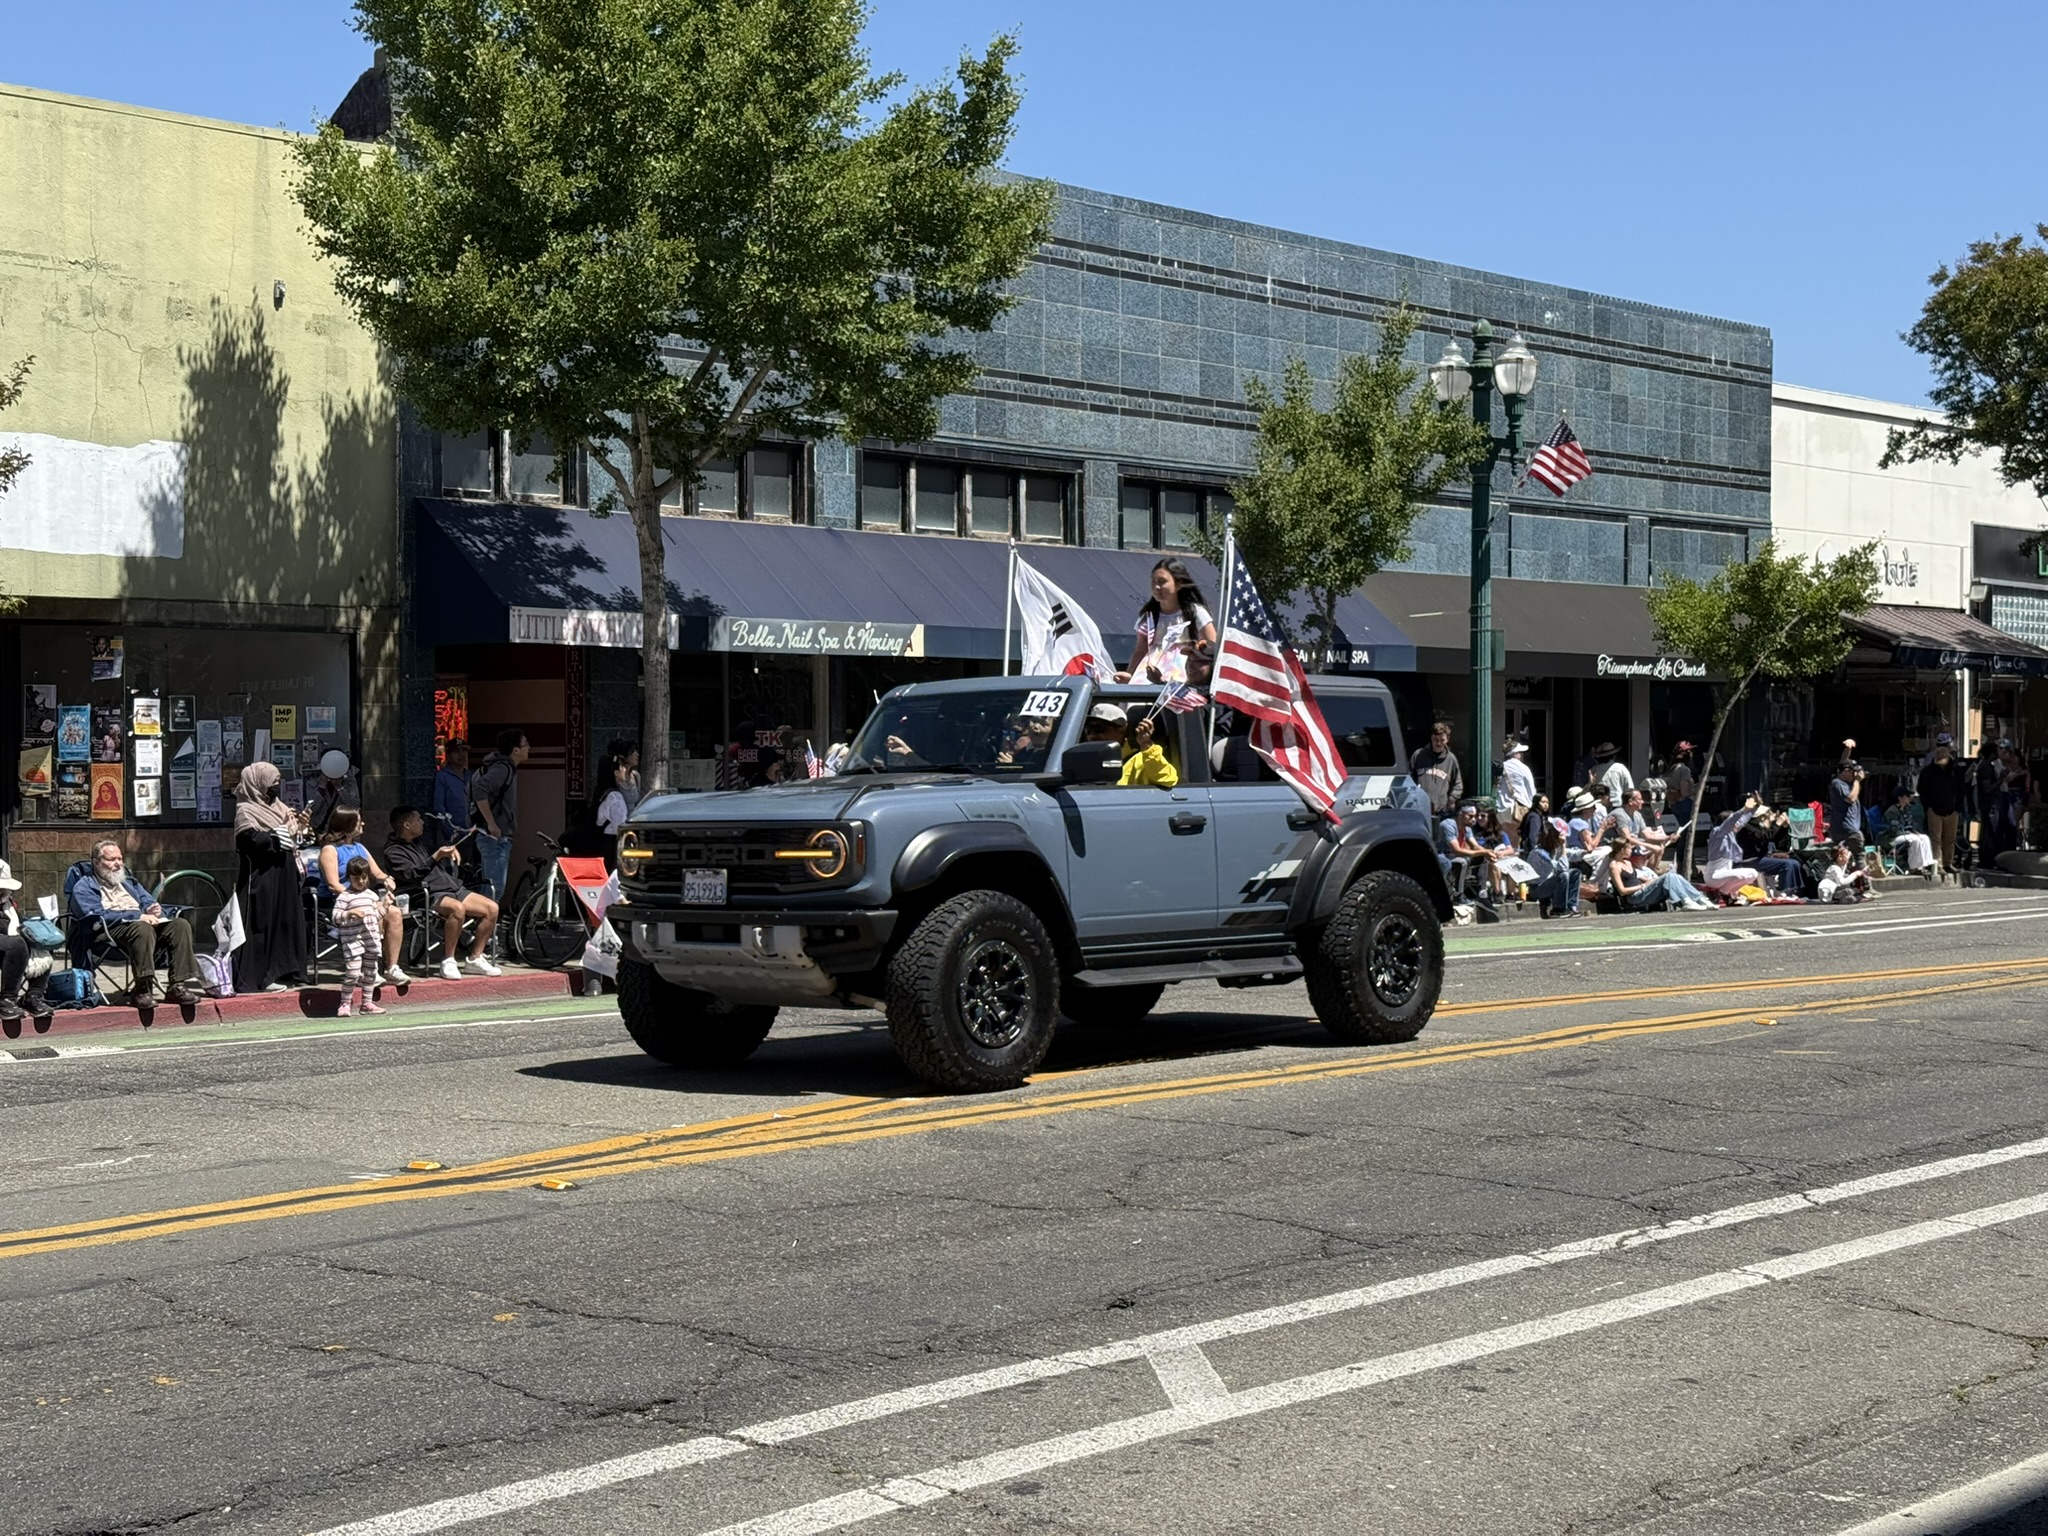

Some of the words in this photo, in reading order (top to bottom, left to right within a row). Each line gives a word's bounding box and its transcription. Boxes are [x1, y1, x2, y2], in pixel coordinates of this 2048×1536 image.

[516, 613, 568, 641] LITTLE
[731, 620, 775, 647] Bella
[777, 622, 812, 649] Nail
[814, 626, 840, 653] Spa
[843, 626, 857, 649] &
[857, 624, 904, 656] Waxing
[1327, 650, 1348, 663] NAIL
[1351, 650, 1370, 664] SPA
[1596, 653, 1653, 679] Triumphant
[1653, 657, 1672, 681] Life
[1672, 658, 1707, 678] Church
[275, 708, 292, 716] IMP
[1025, 694, 1062, 712] 143
[754, 730, 783, 748] TK
[570, 727, 581, 789] TELLER
[1345, 797, 1394, 809] RAPTOR
[685, 882, 725, 899] 95199X3
